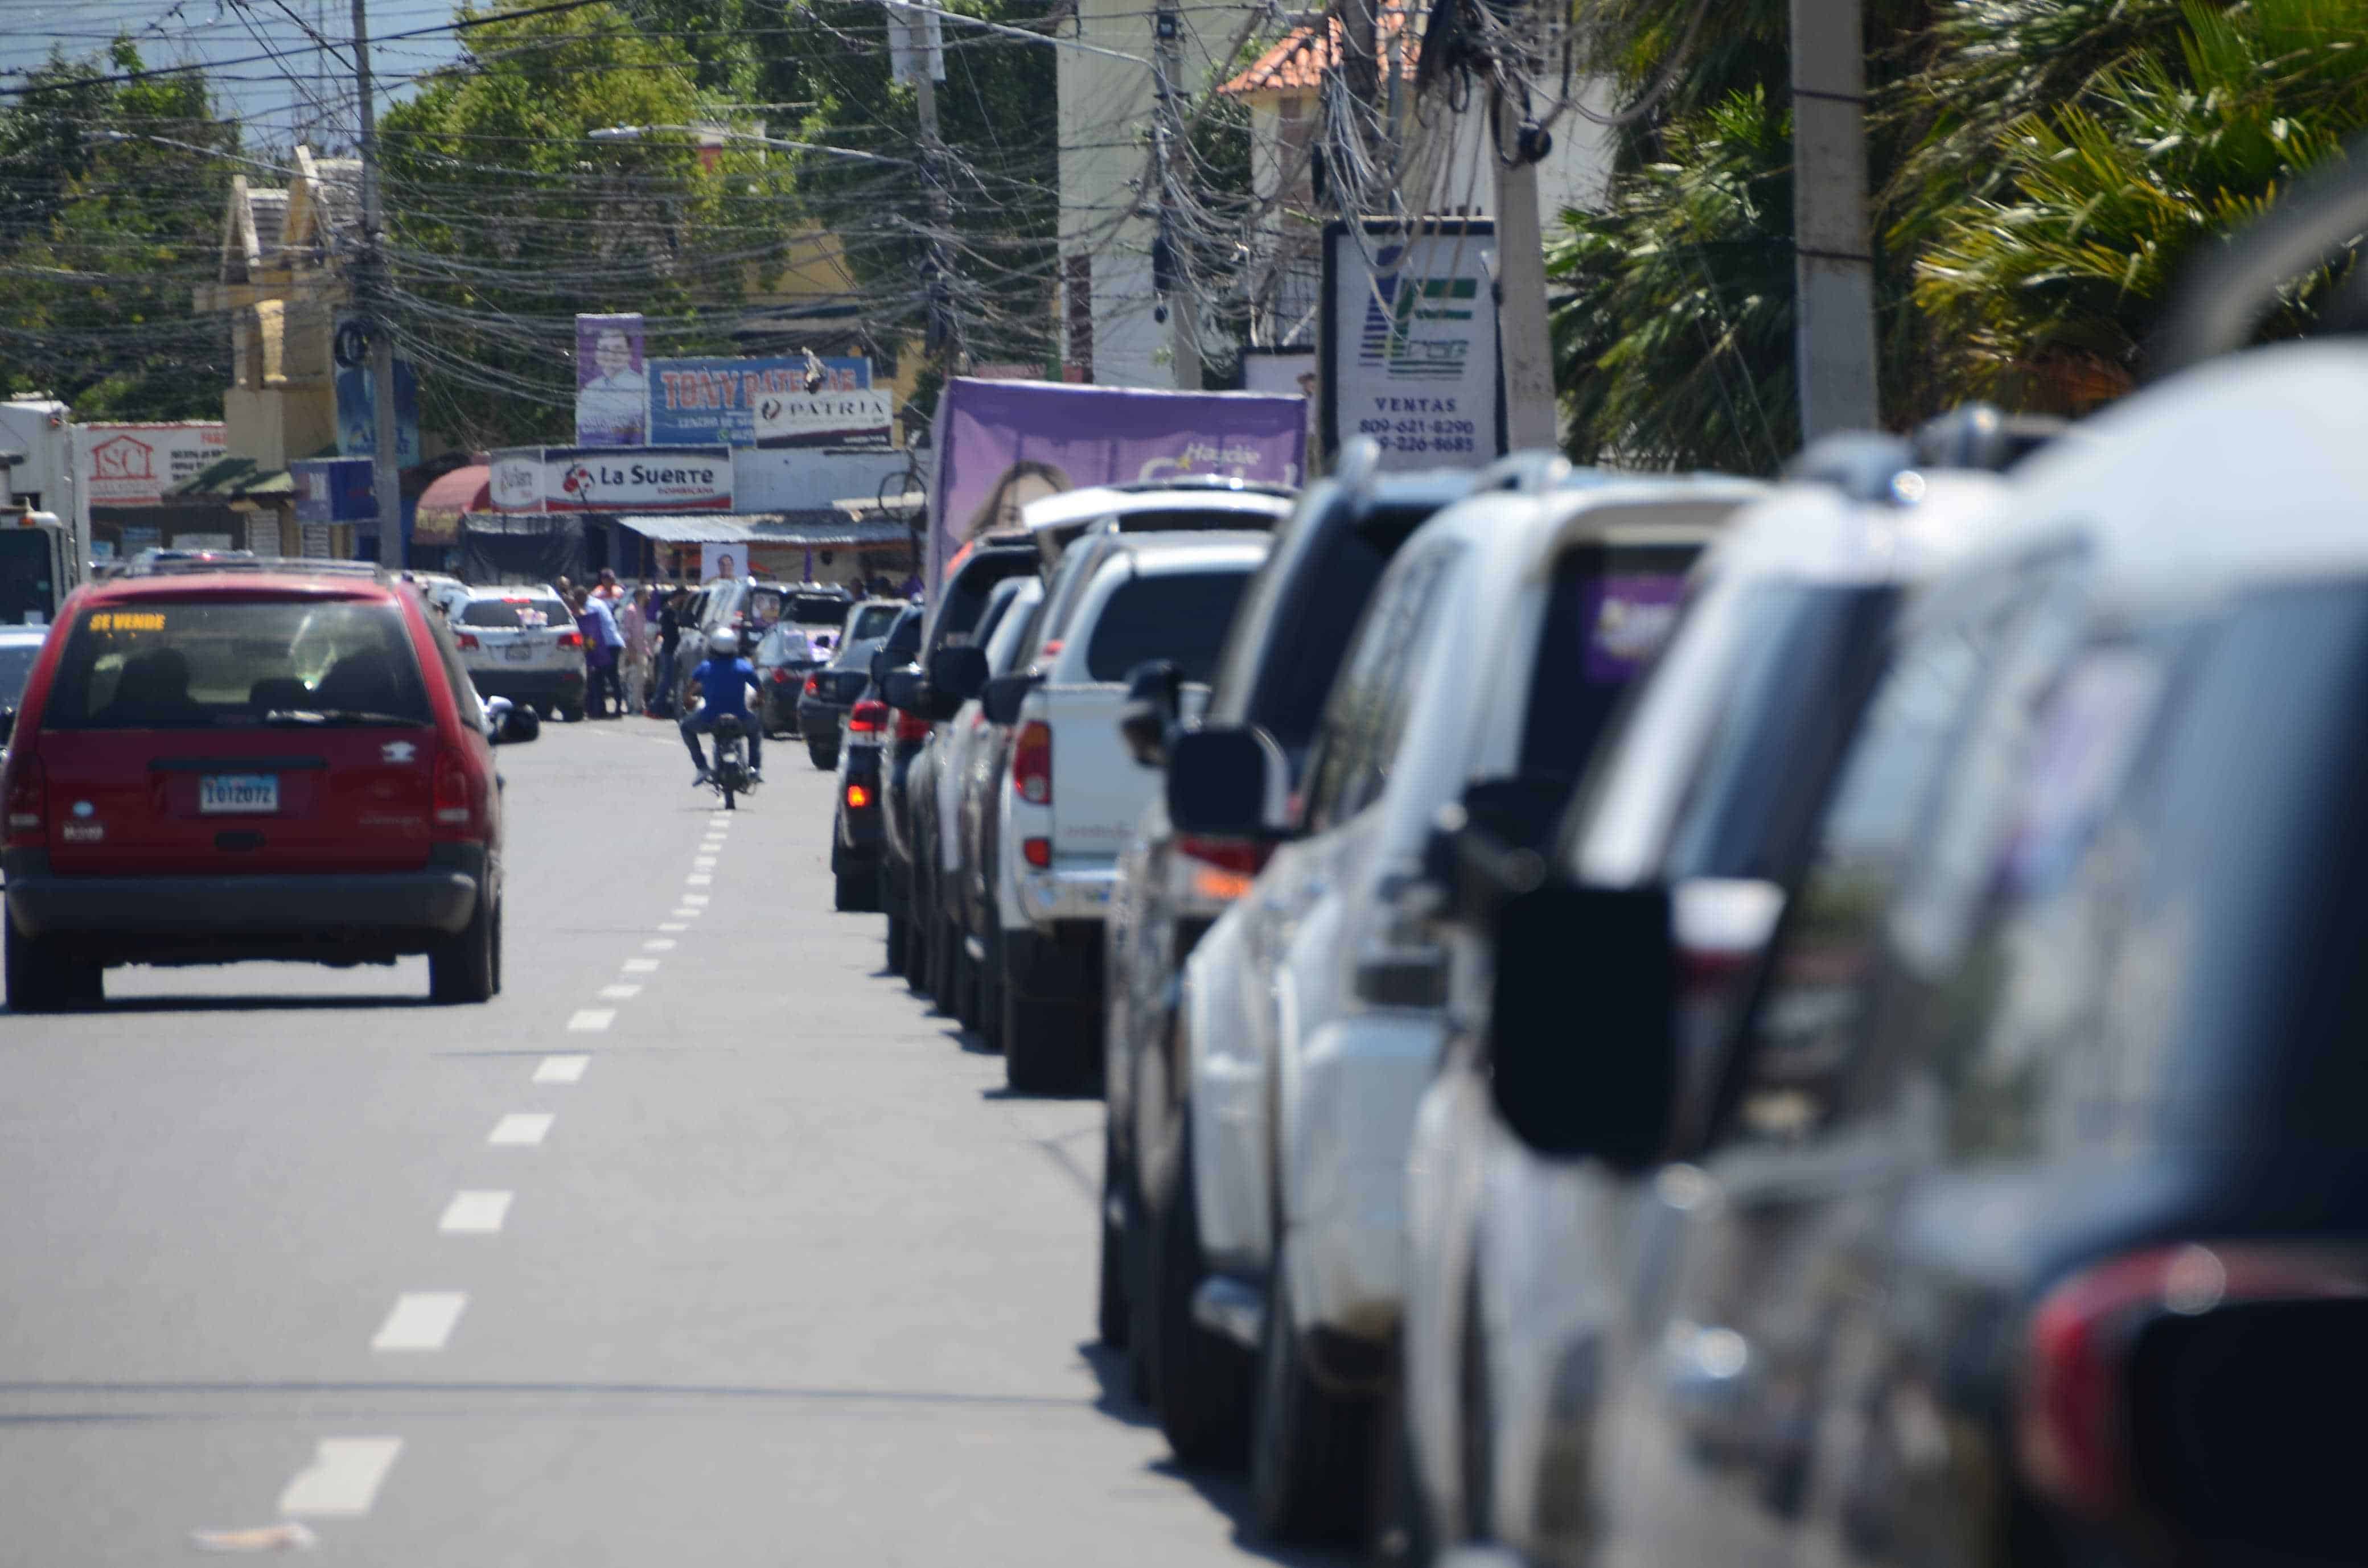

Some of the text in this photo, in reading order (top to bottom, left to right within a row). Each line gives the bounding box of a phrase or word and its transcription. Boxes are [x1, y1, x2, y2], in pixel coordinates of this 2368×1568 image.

[660, 370, 739, 410] TONY
[790, 398, 884, 415] PATRIA
[1375, 397, 1457, 412] VENTAS
[601, 464, 624, 485] La
[89, 612, 166, 632] SE VENDE
